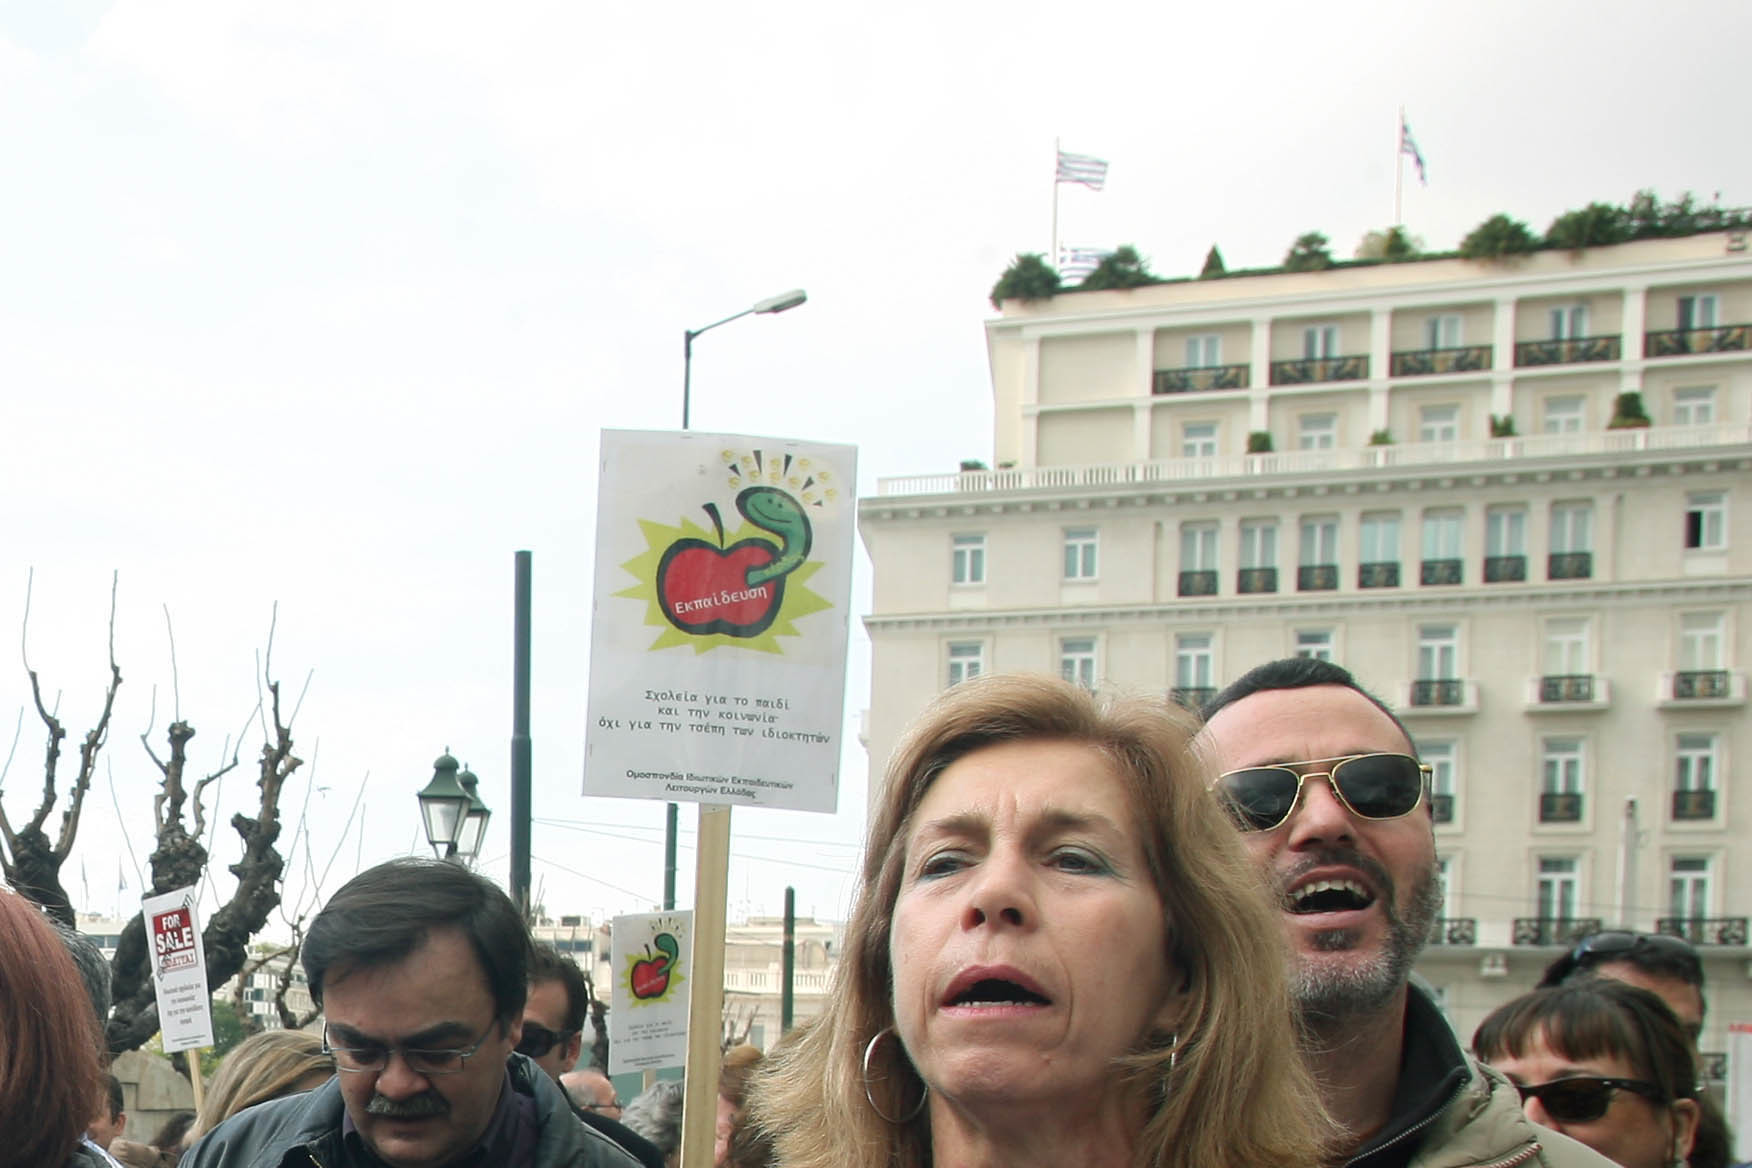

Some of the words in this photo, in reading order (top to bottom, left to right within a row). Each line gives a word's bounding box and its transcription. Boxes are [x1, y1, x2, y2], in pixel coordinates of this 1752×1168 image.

[674, 586, 768, 615] Εκπαίδευση
[645, 690, 698, 702] Σχολεία
[704, 694, 727, 706] για
[734, 697, 748, 707] το
[755, 698, 790, 711] παιδί
[657, 706, 679, 716] και
[688, 708, 710, 720] την
[598, 717, 620, 730] όχι
[629, 720, 652, 731] για
[659, 721, 681, 733] την
[689, 722, 725, 736] τσέπη
[733, 725, 755, 736] των
[762, 727, 830, 745] ιδιοκτητών
[161, 914, 181, 931] FOR
[156, 926, 194, 953] SALE
